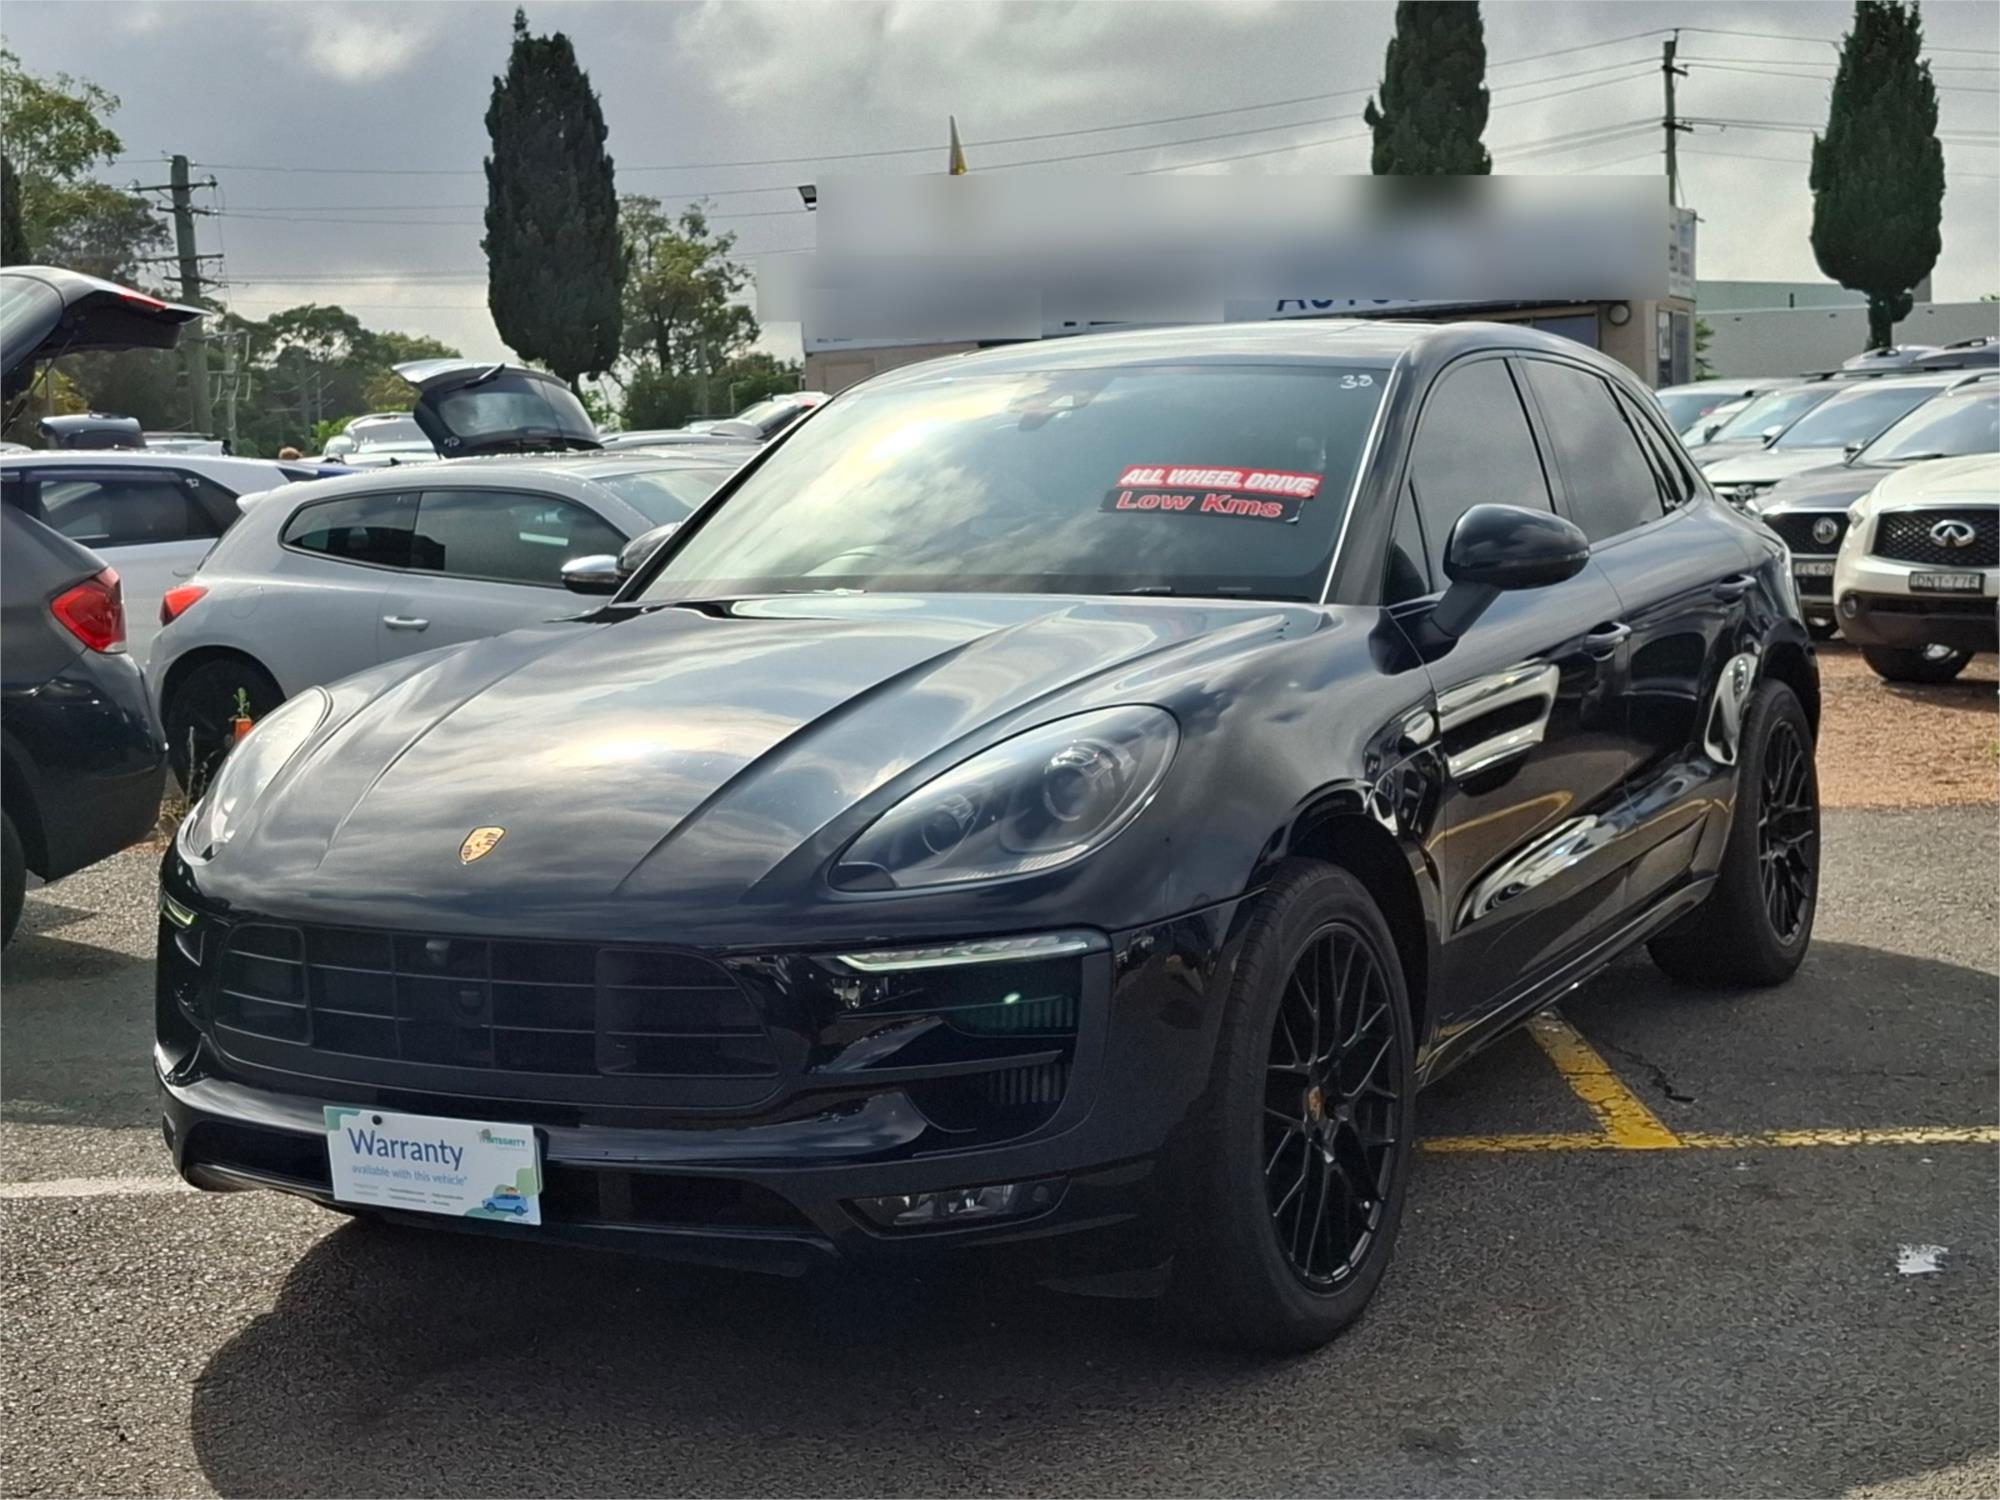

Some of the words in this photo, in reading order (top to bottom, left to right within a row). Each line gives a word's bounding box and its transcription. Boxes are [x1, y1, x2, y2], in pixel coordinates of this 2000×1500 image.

[1120, 468, 1165, 485] ALL
[1167, 469, 1243, 488] WHEEL
[1244, 473, 1319, 493] DRIVE
[1116, 490, 1196, 511] Low
[1200, 493, 1284, 518] Kms
[347, 1127, 464, 1172] Warranty
[352, 1164, 390, 1178] available
[391, 1169, 412, 1180] with
[414, 1171, 431, 1182] this
